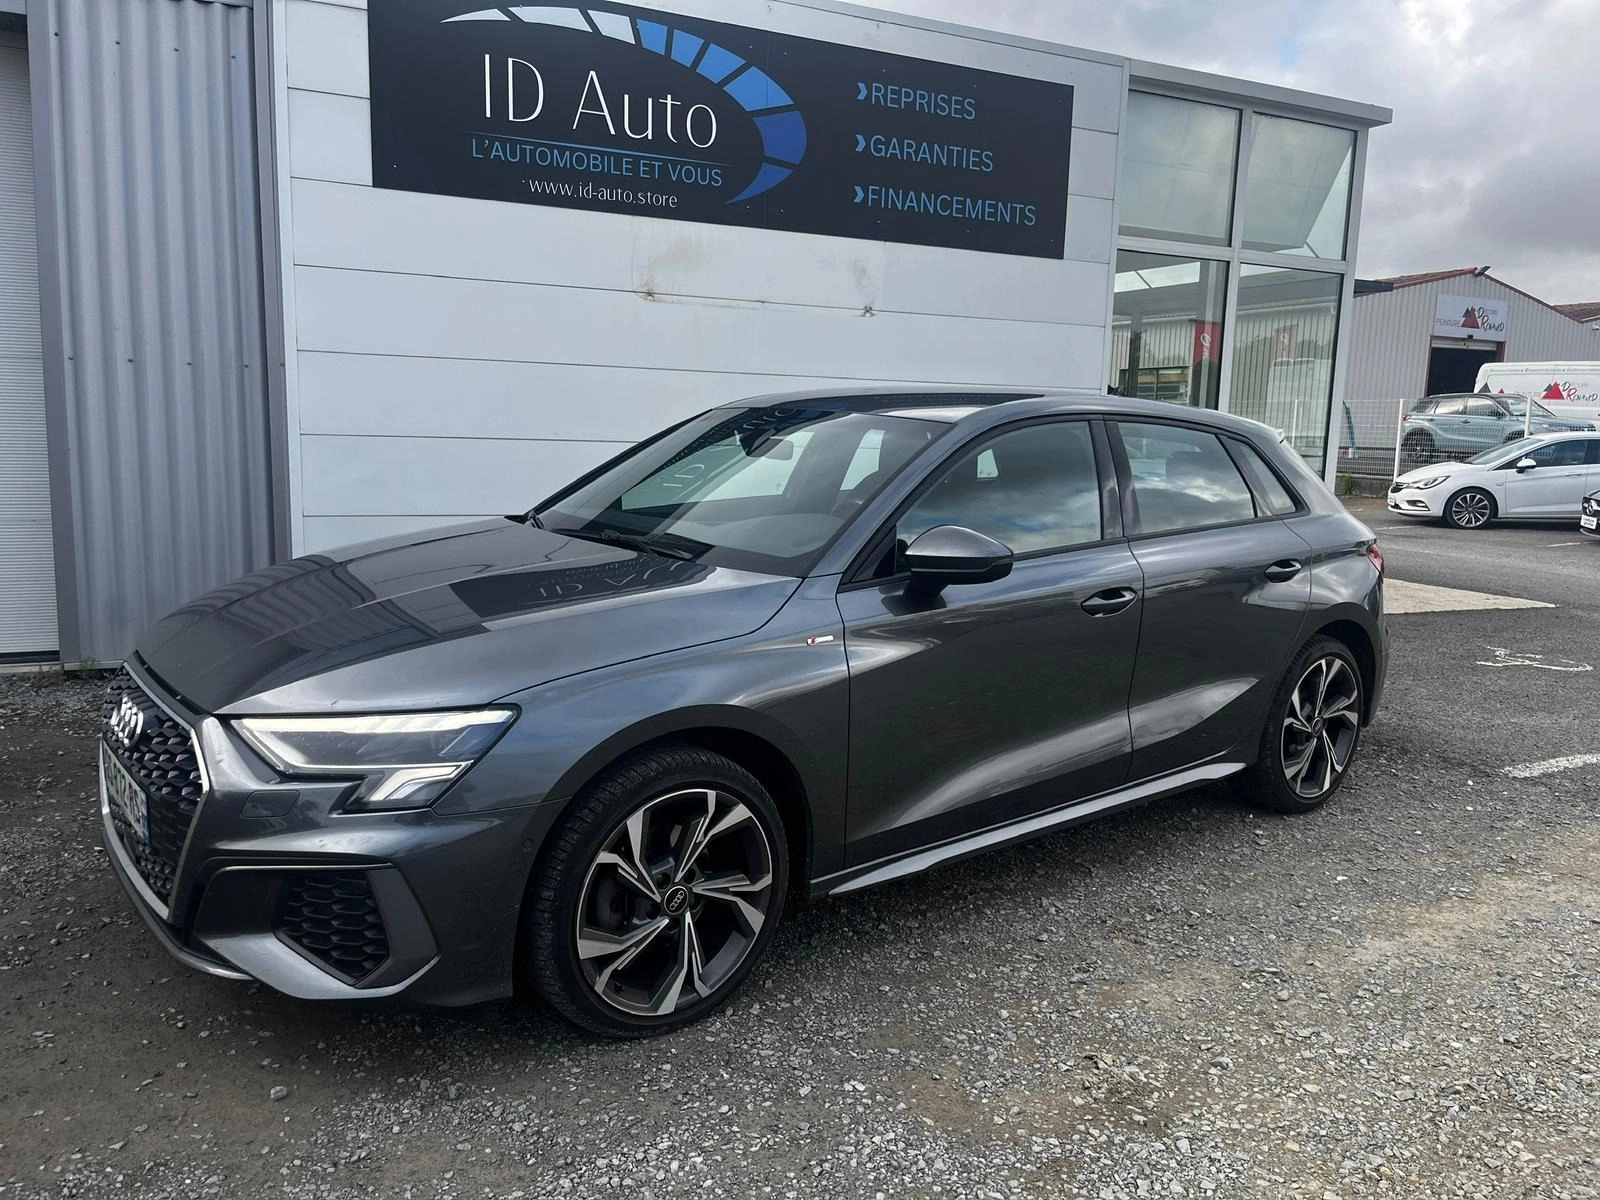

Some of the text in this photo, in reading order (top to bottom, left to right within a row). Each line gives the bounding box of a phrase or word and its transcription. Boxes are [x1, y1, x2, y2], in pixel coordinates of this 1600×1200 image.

[484, 53, 718, 149] ID Auto
[871, 82, 977, 121] REPRISES
[471, 137, 724, 188] L'AUTOMOBILE ET VOUS
[869, 134, 994, 173] GARANTIES
[528, 178, 679, 209] www.id-auto.store
[867, 185, 1037, 227] FINANCEMENTS
